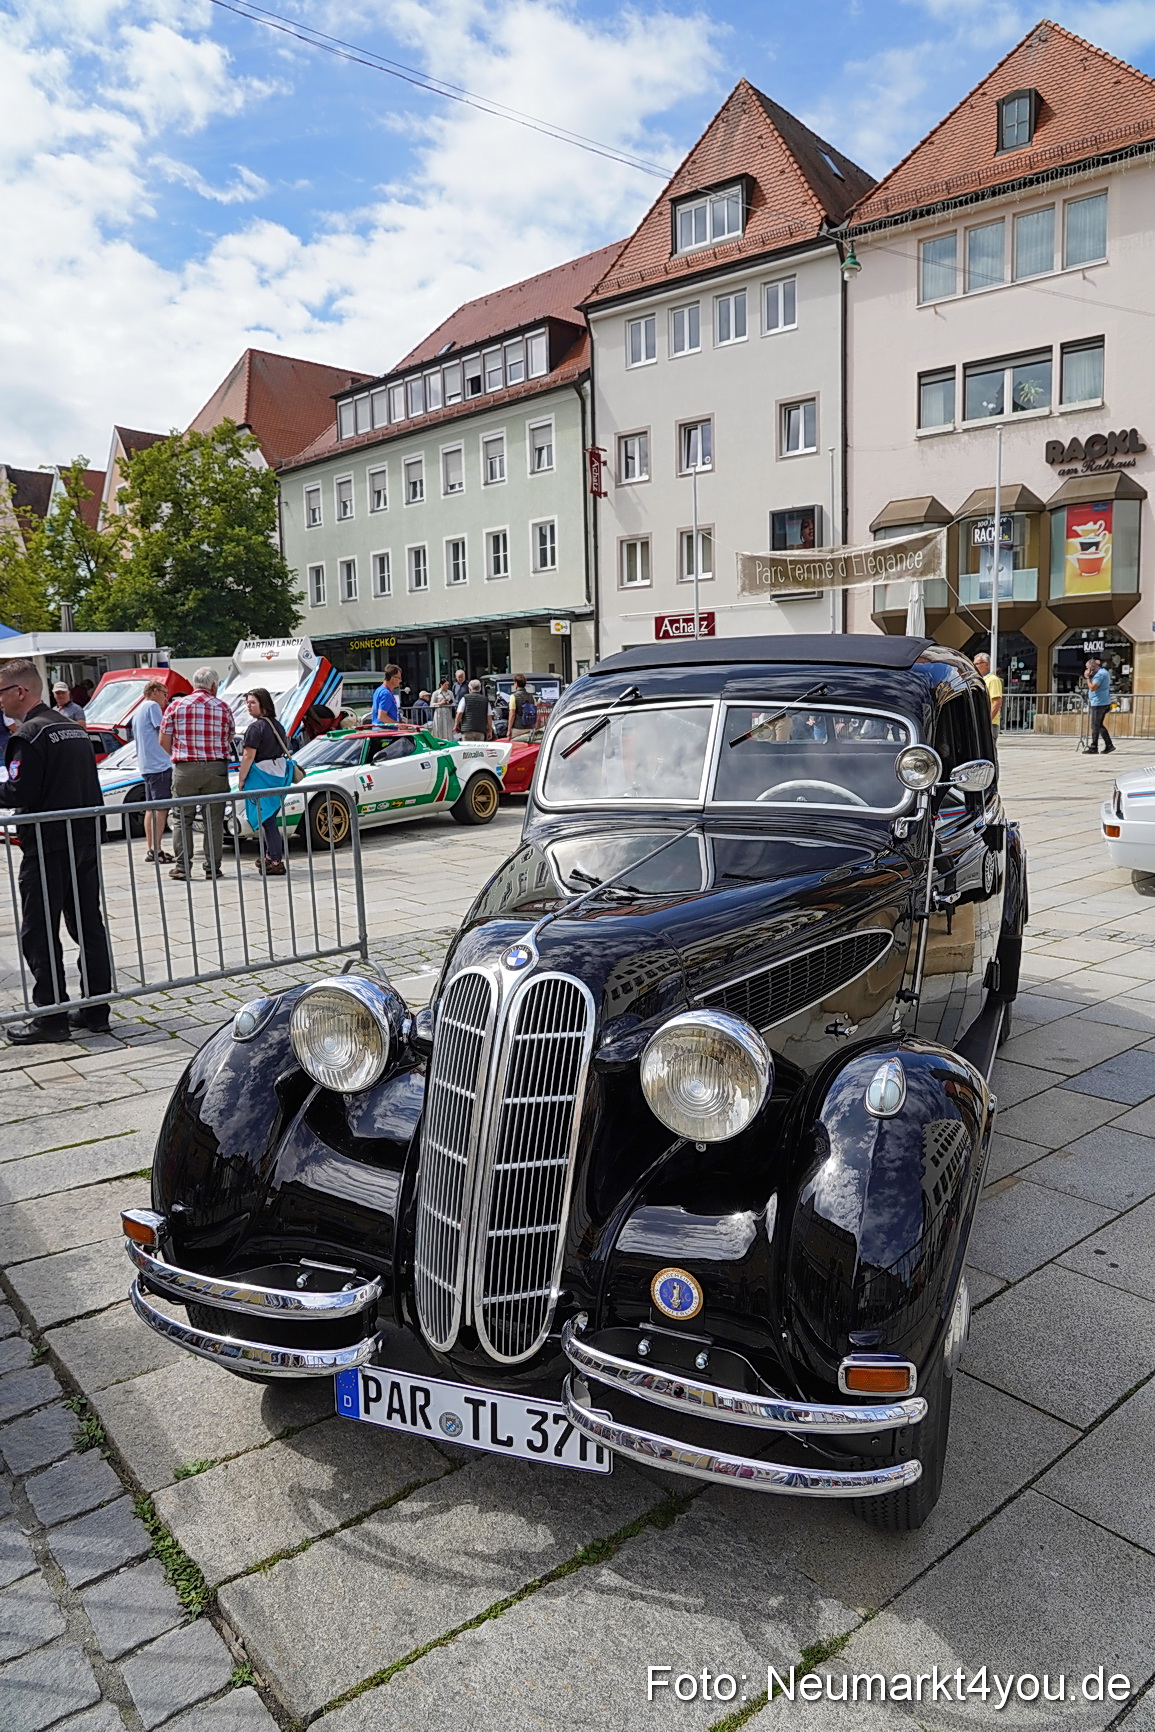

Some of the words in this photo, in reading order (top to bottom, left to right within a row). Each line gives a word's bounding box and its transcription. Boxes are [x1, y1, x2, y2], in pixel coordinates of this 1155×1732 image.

[1045, 428, 1147, 465] RACKL
[1058, 467, 1078, 476] am
[1081, 458, 1136, 473] Rathaus
[988, 517, 1008, 526] Jare
[756, 560, 785, 585] Parc
[787, 555, 834, 582] Fermé
[659, 617, 708, 637] Achaz
[244, 641, 275, 649] MARTINI
[1084, 641, 1104, 651] RACKL
[343, 1394, 352, 1408] D
[361, 1374, 432, 1430] PAR
[463, 1396, 513, 1447] TL
